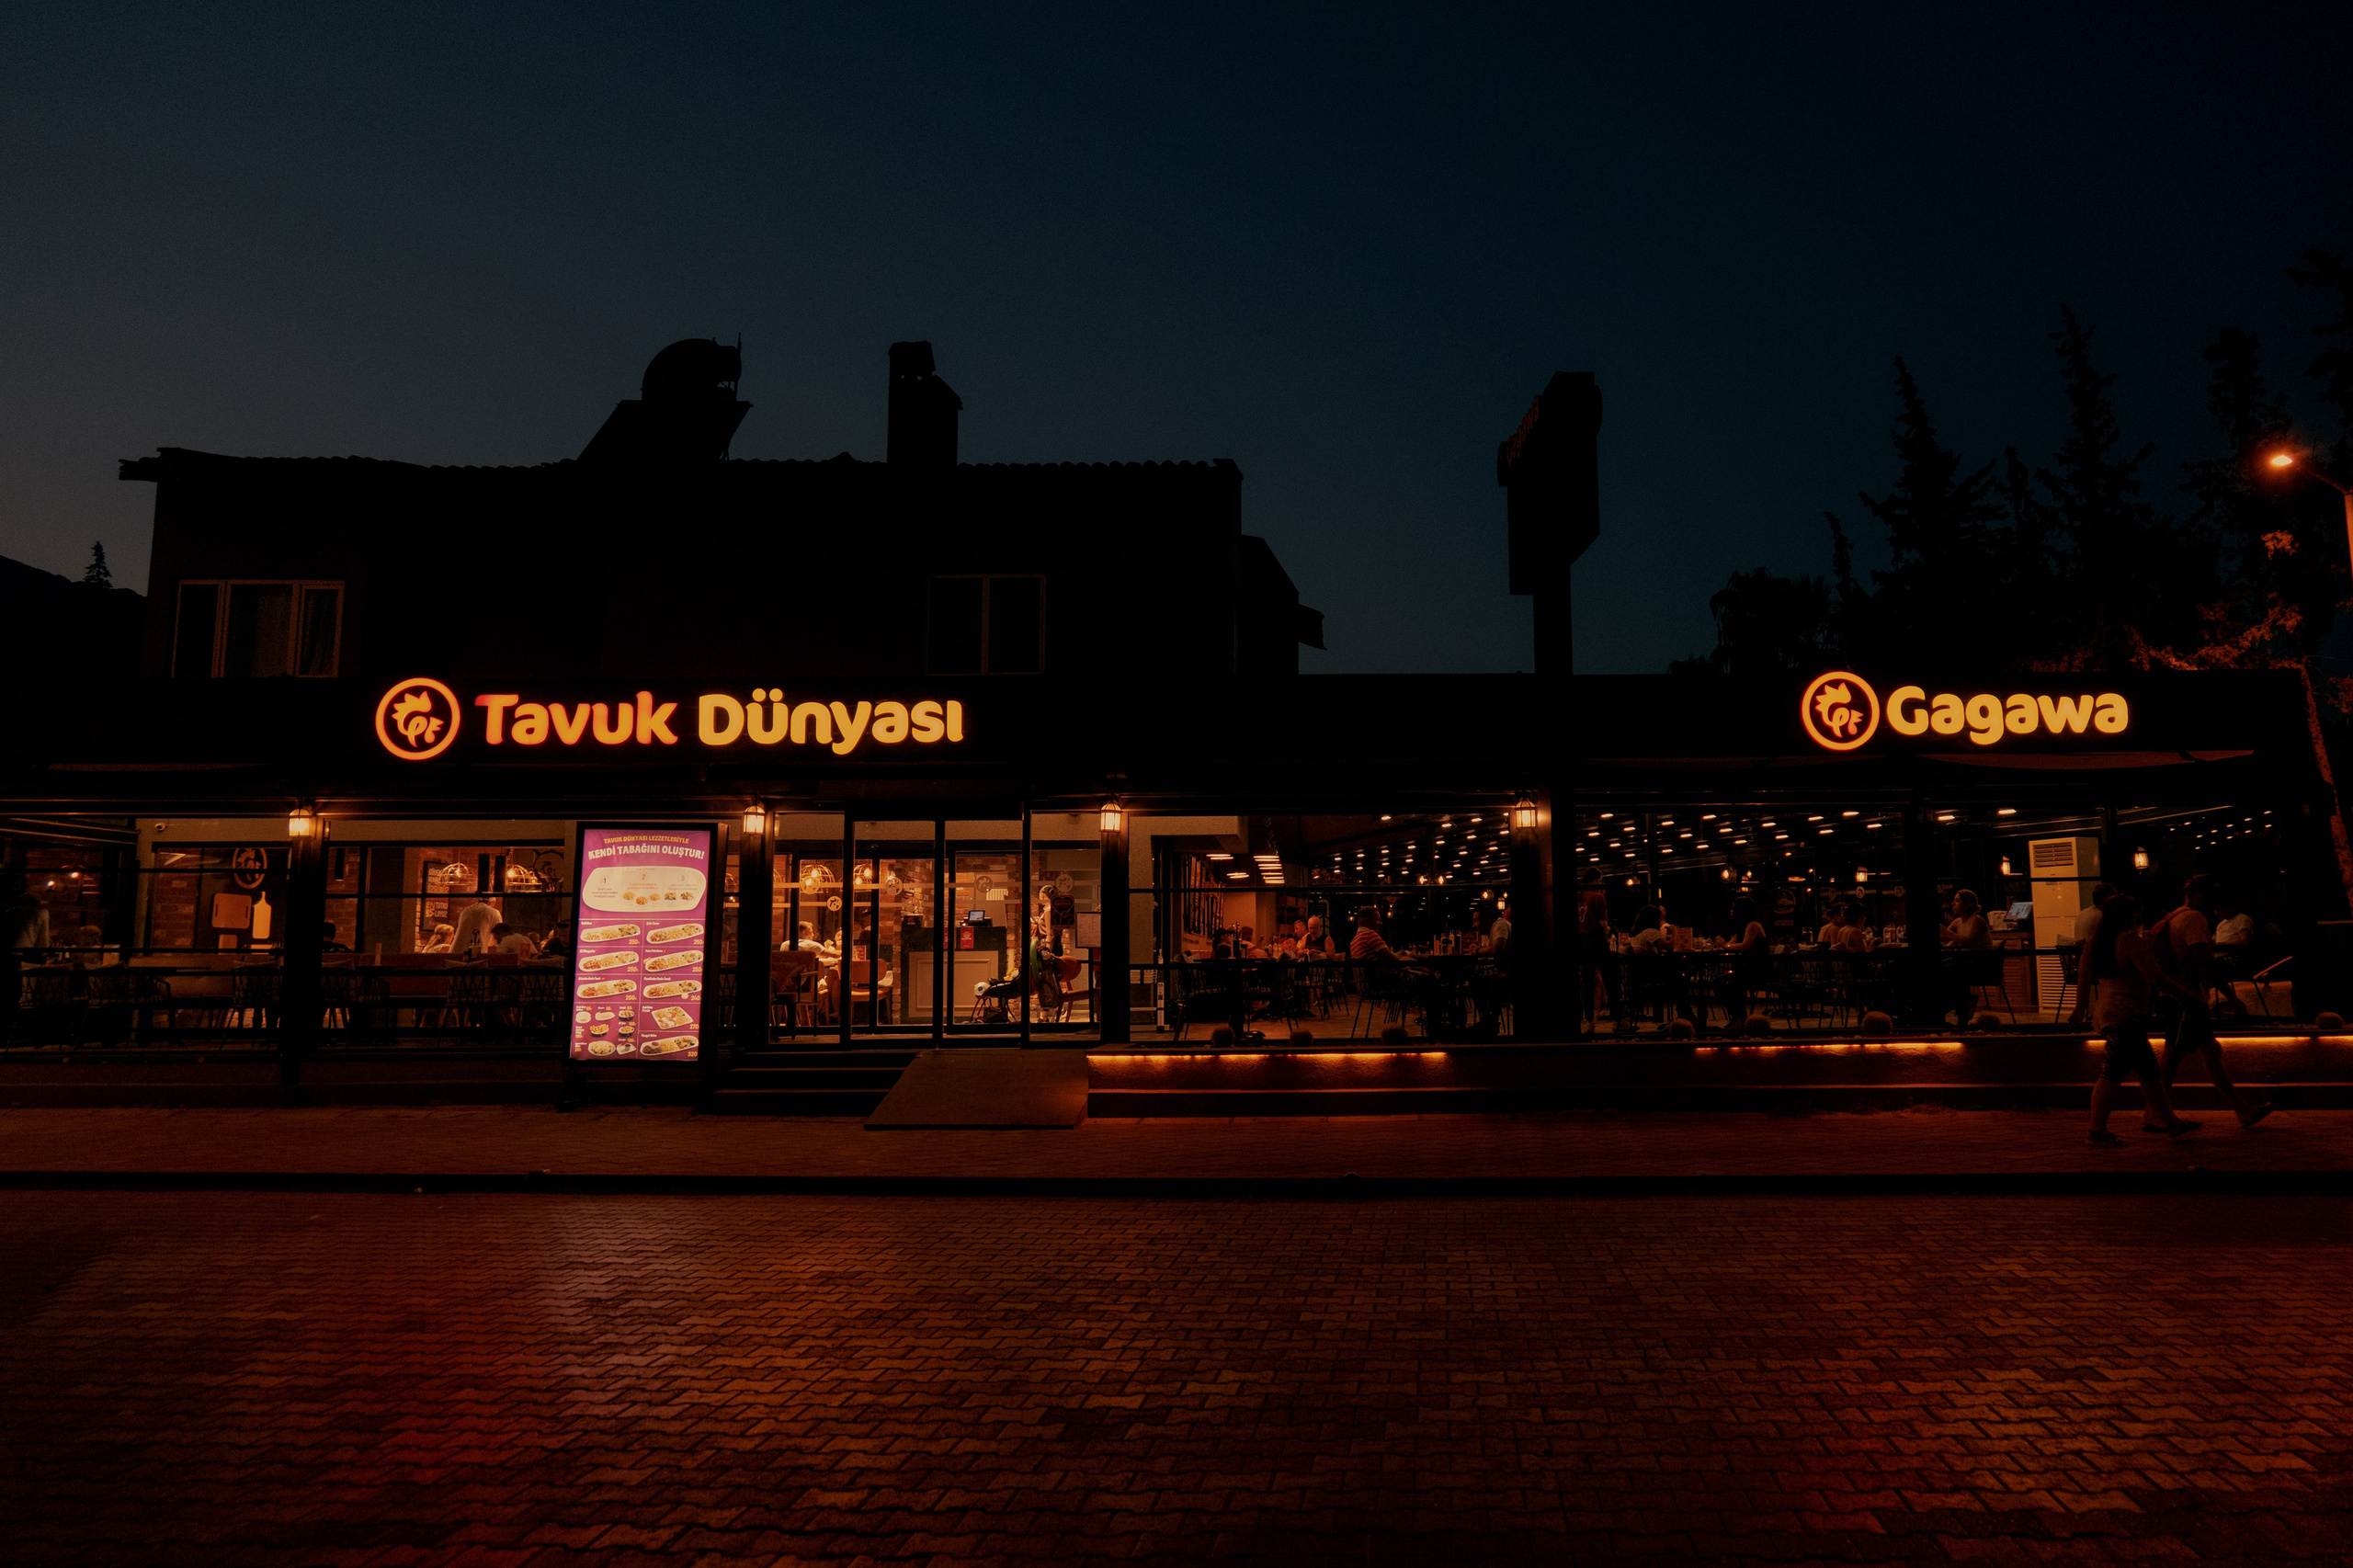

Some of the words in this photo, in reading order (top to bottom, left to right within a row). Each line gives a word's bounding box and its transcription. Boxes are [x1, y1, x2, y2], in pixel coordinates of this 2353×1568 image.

[475, 691, 678, 744] Tavuk
[699, 687, 963, 755] Dünyası
[1887, 686, 2128, 744] Gagawa
[588, 845, 616, 860] KENDİ
[617, 843, 660, 855] TABAĞINI
[662, 846, 705, 859] OLUŞTUR!
[649, 835, 689, 844] LEZZETLERİYLE
